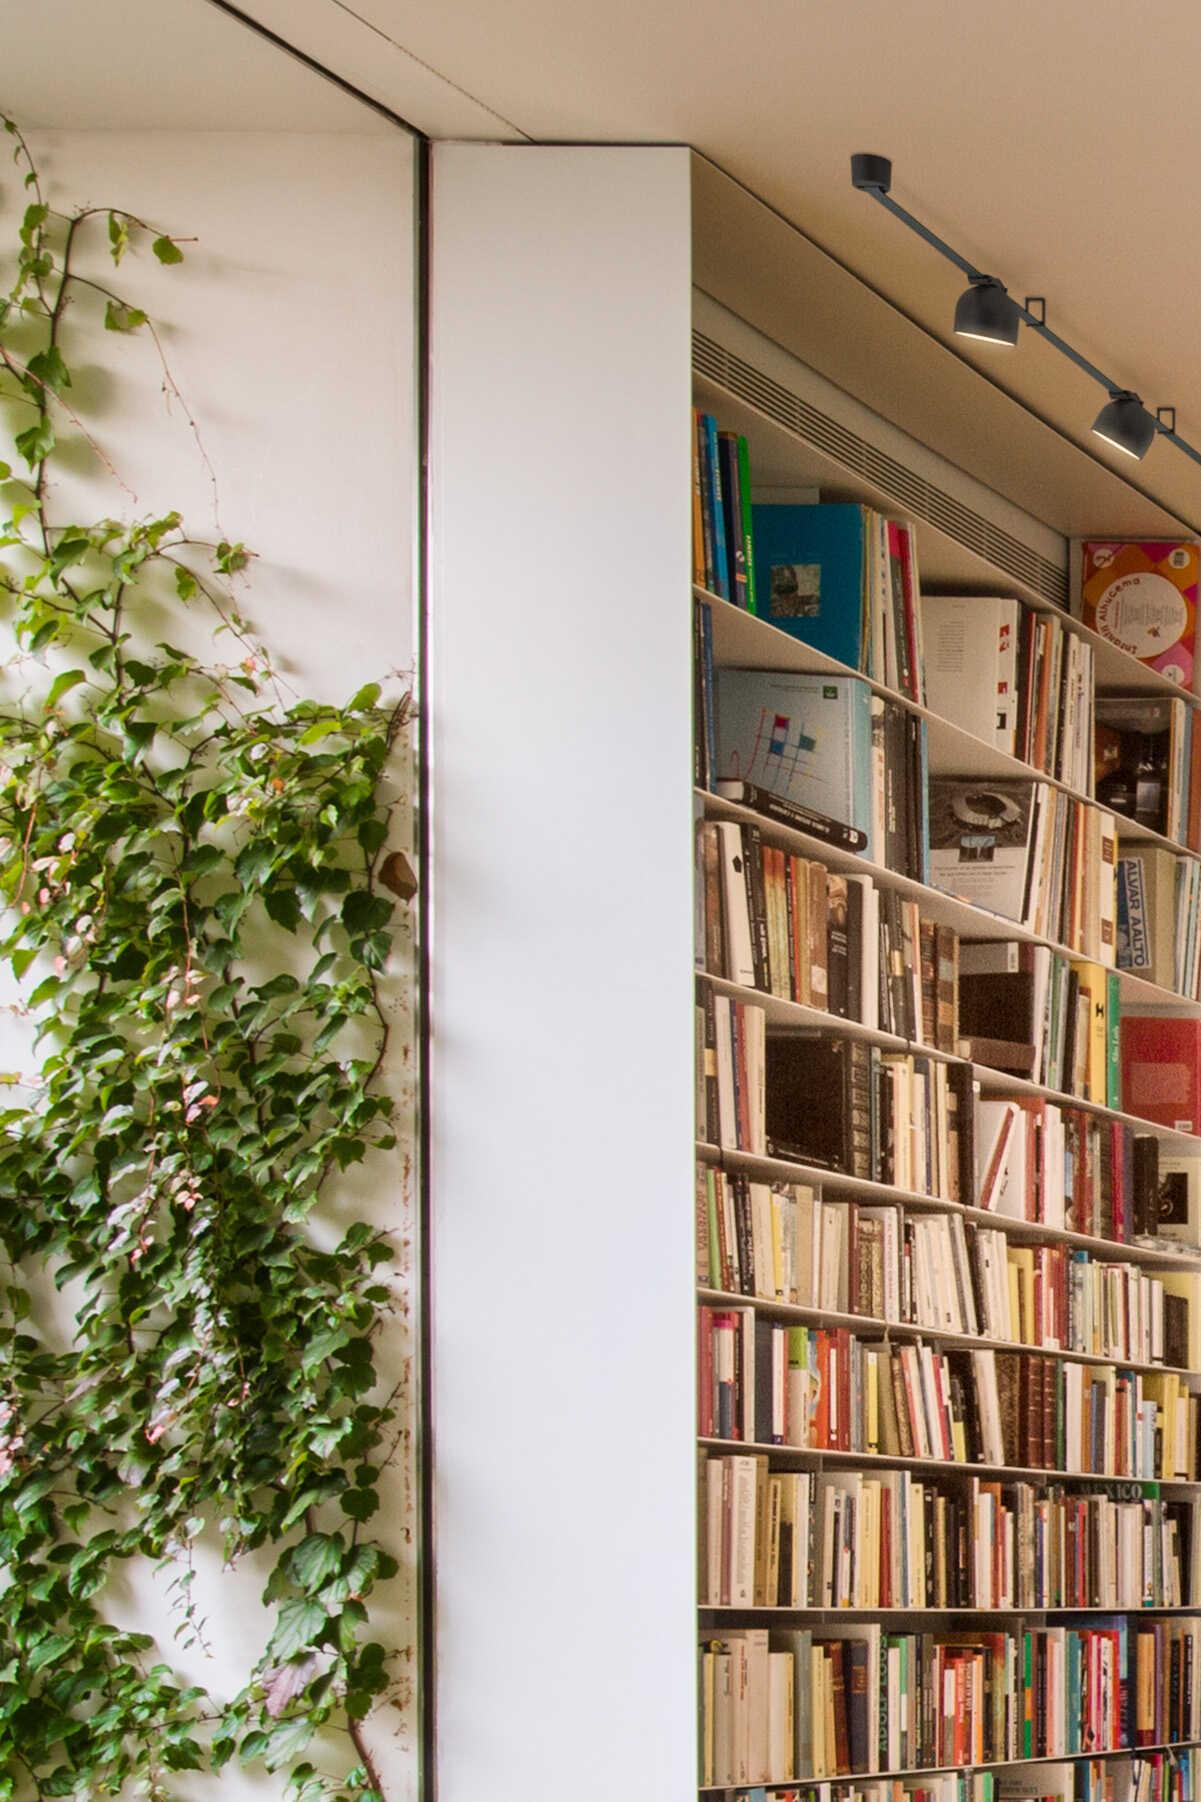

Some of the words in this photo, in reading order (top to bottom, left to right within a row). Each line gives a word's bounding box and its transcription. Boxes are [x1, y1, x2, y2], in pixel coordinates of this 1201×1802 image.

[1098, 577, 1141, 622] Alhucema
[1126, 860, 1140, 910] ALVAR
[1130, 916, 1145, 967] AALTO
